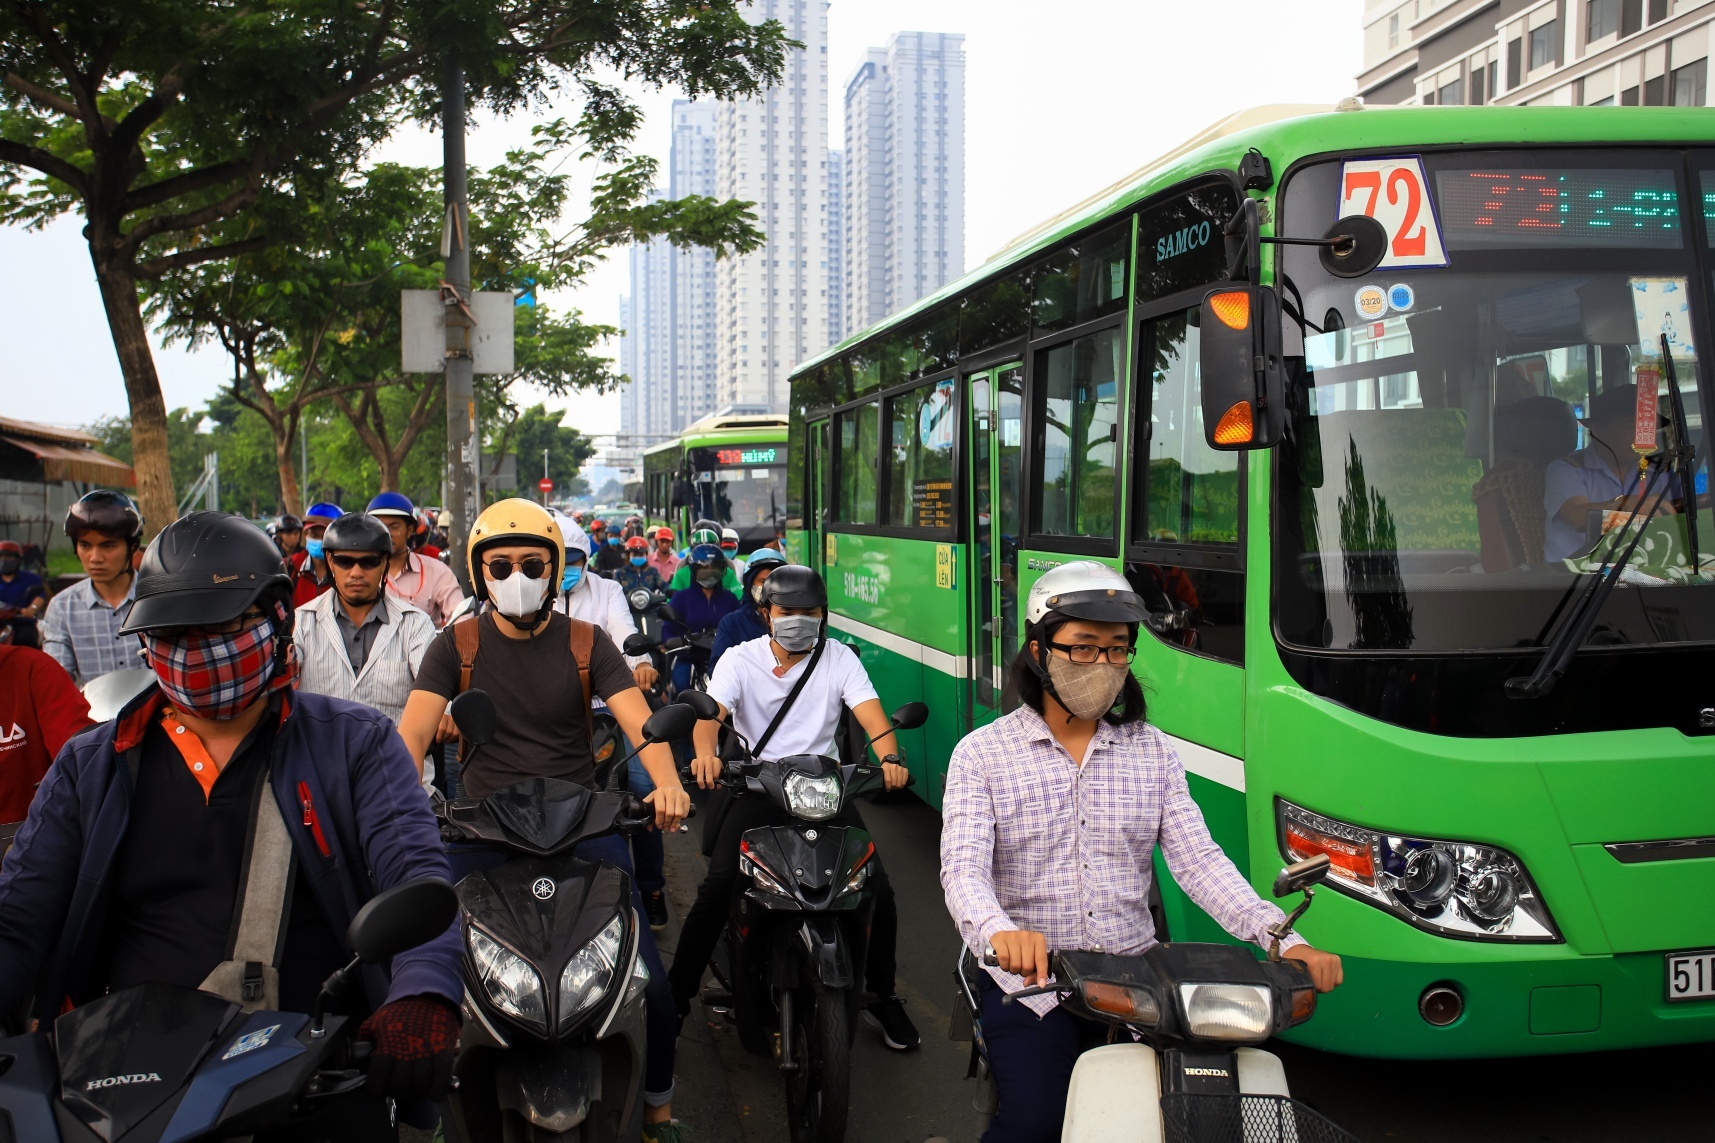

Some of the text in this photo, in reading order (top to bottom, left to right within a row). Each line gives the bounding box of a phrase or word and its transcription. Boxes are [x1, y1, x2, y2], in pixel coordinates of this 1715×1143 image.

[1345, 168, 1426, 257] 72
[1470, 173, 1561, 227] 72
[1157, 221, 1210, 262] SAMCO
[1361, 297, 1381, 306] 03/20
[1674, 958, 1715, 993] 51
[86, 1073, 162, 1090] HONDA
[1184, 1067, 1229, 1077] HONDA
